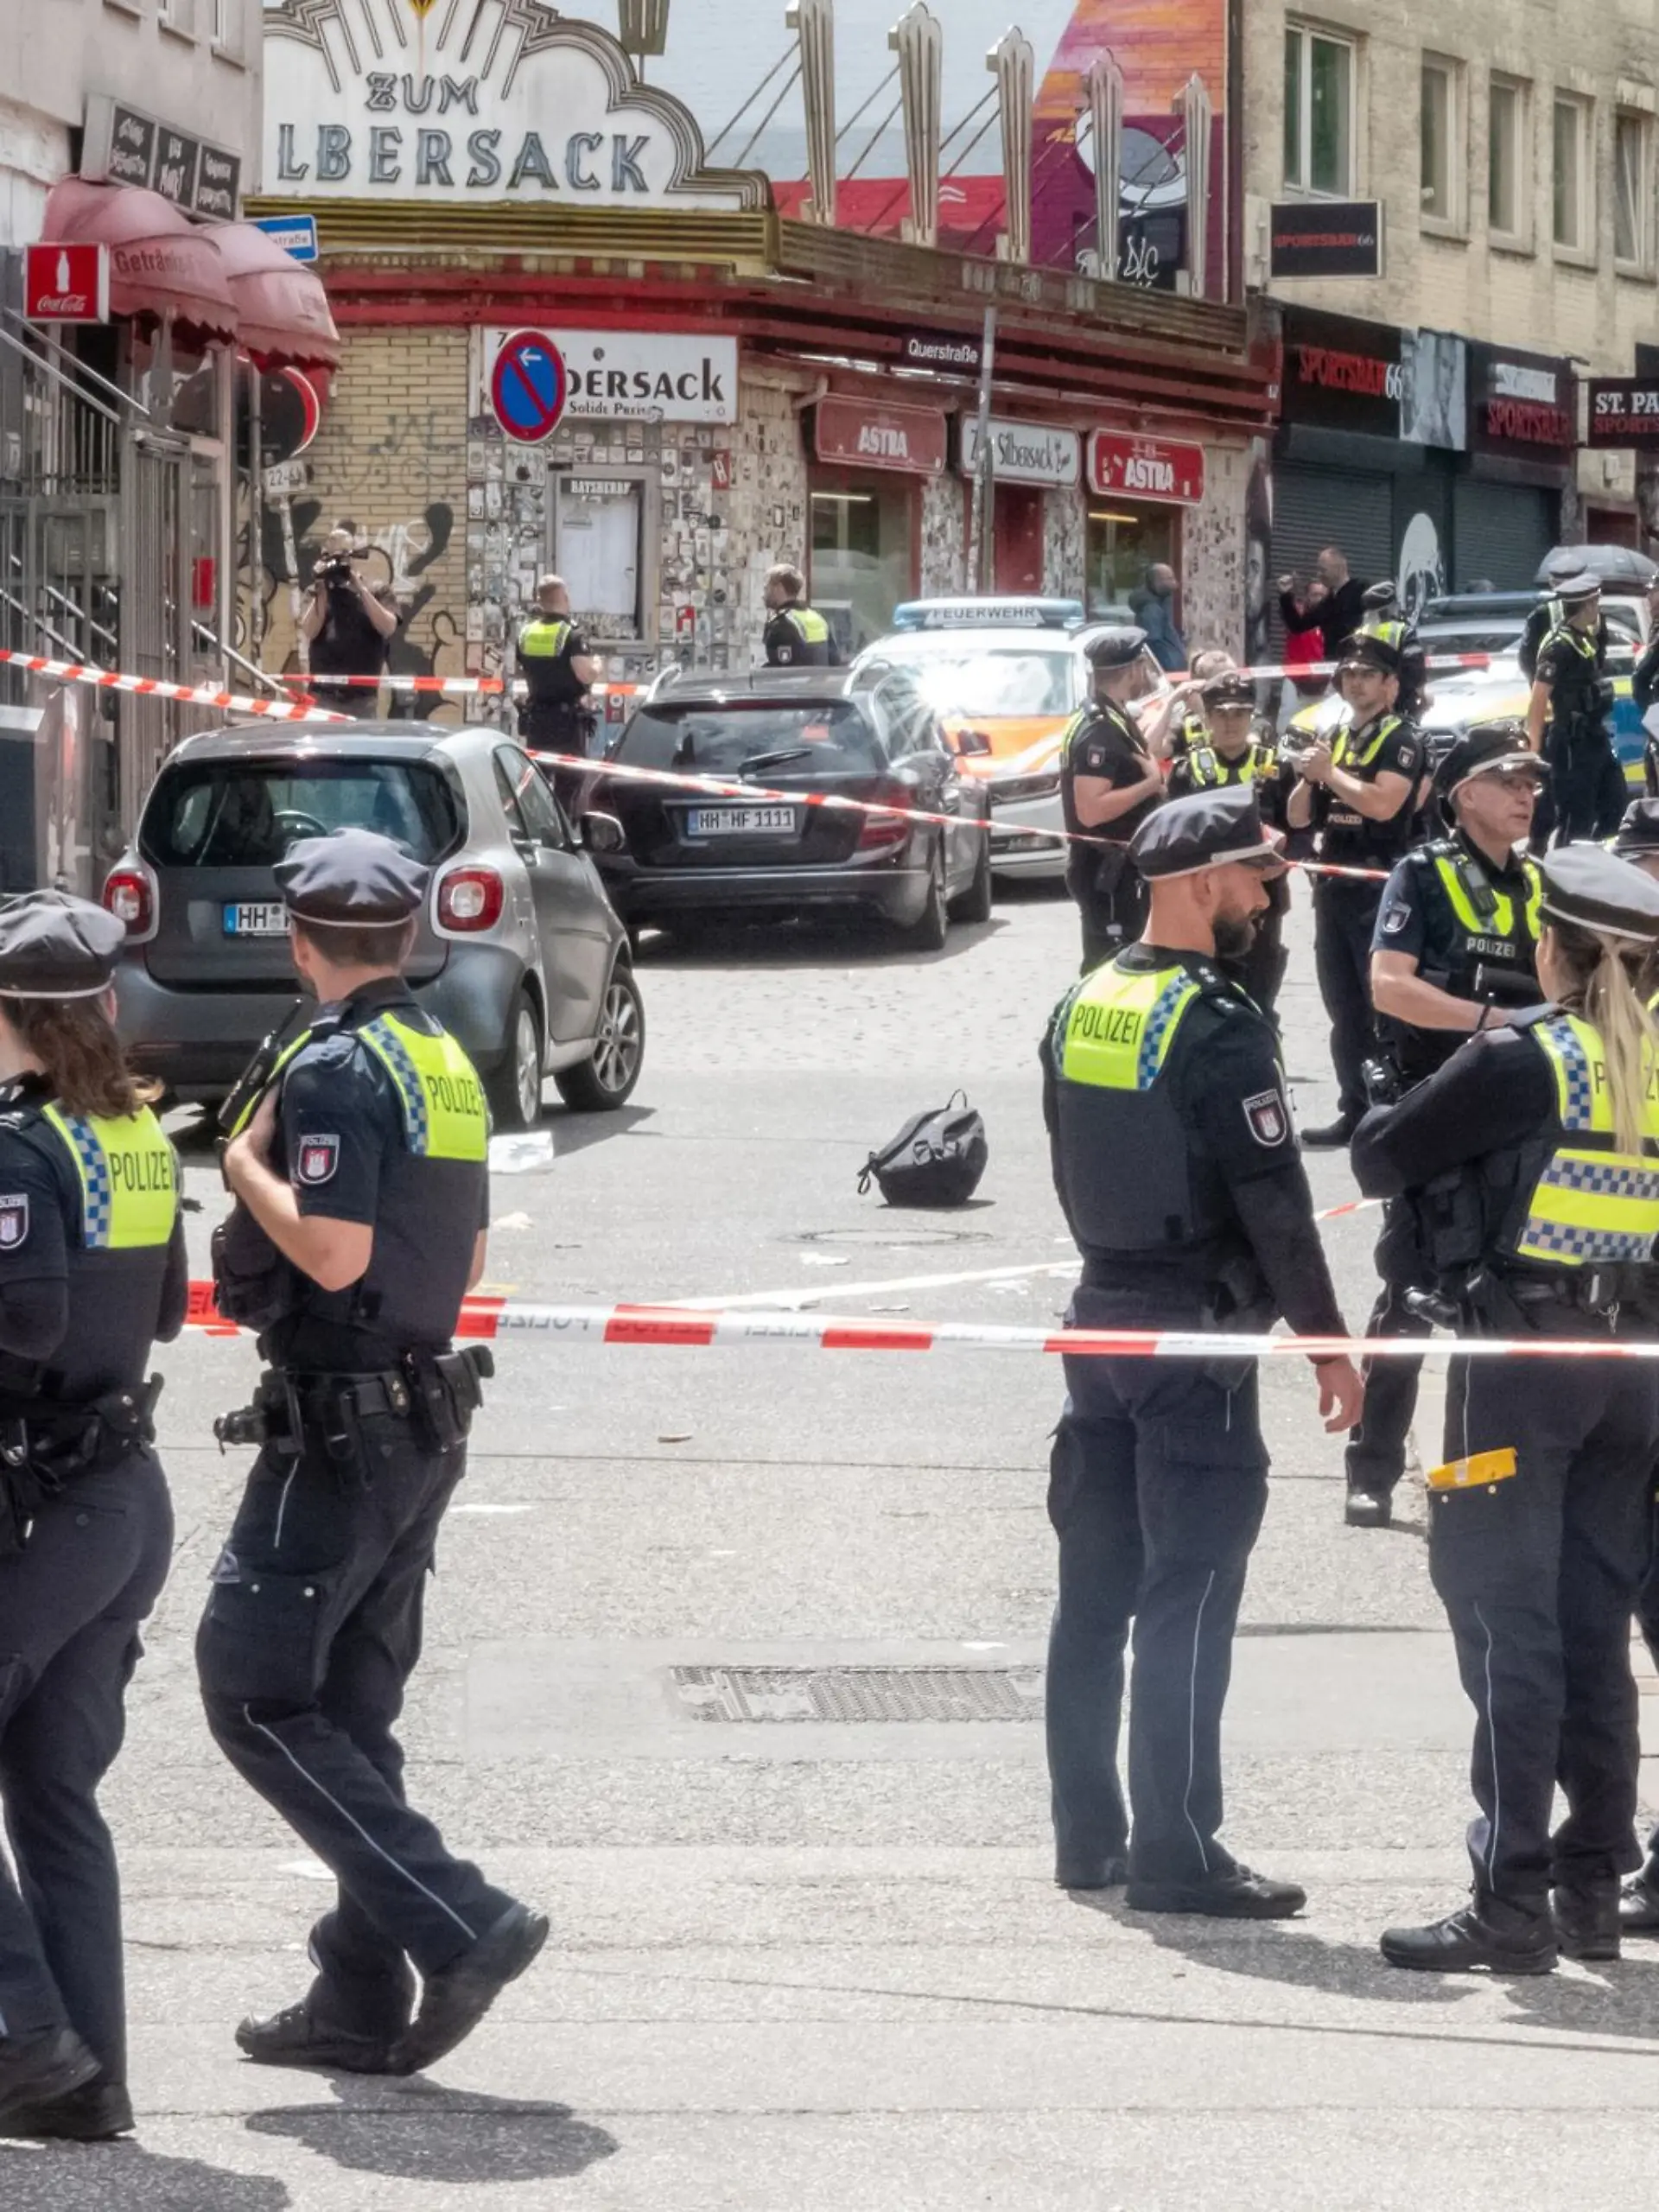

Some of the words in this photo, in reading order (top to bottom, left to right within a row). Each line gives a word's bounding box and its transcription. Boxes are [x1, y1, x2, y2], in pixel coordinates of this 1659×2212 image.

[365, 71, 478, 115] ZUM
[908, 338, 978, 364] Querstraße
[1595, 391, 1625, 415] ST.
[856, 424, 908, 458] ASTRA
[1124, 457, 1174, 493] ASTRA
[932, 607, 1034, 619] FEUERWEHR
[754, 810, 791, 827] 1111
[238, 906, 268, 929] HH
[1466, 937, 1516, 958] POLIZEI
[1071, 1004, 1143, 1046] POLIZEI
